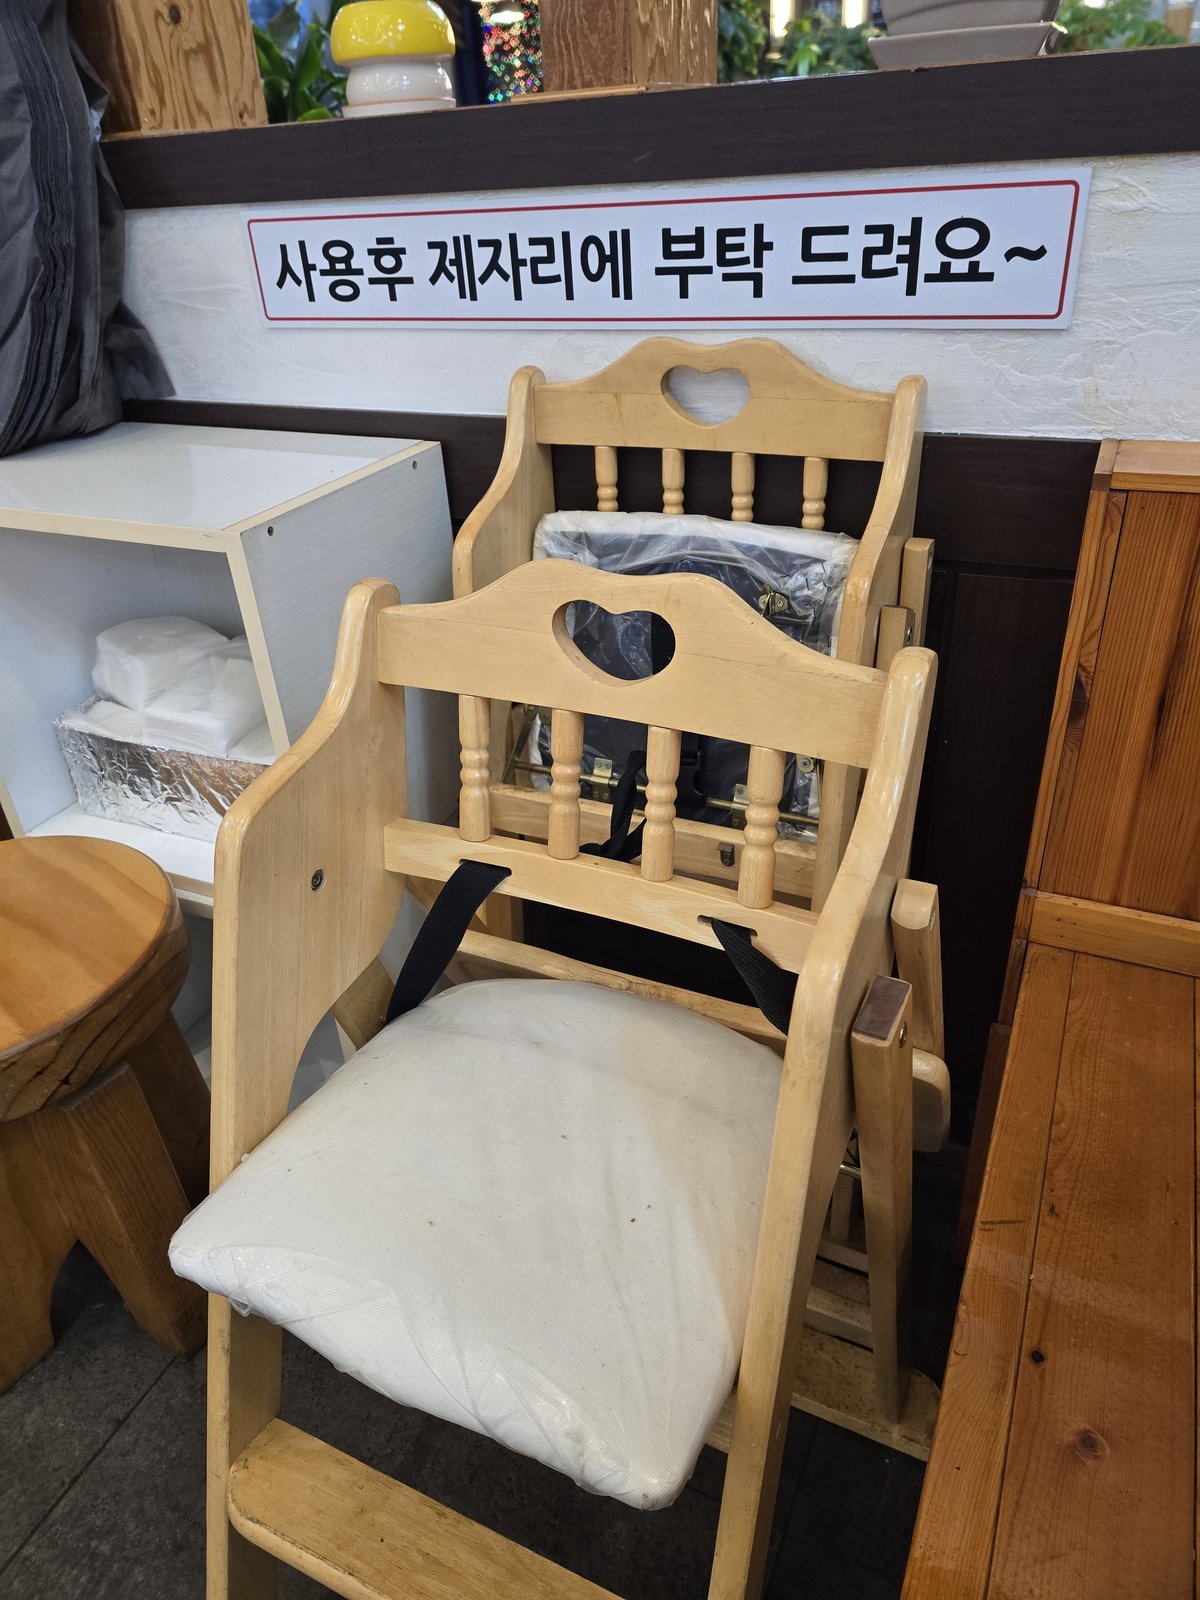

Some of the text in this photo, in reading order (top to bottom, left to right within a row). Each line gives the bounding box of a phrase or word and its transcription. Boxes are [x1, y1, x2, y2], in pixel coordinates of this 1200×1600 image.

[276, 216, 1048, 303] 사용후 제자리에 부탁 드려요~
